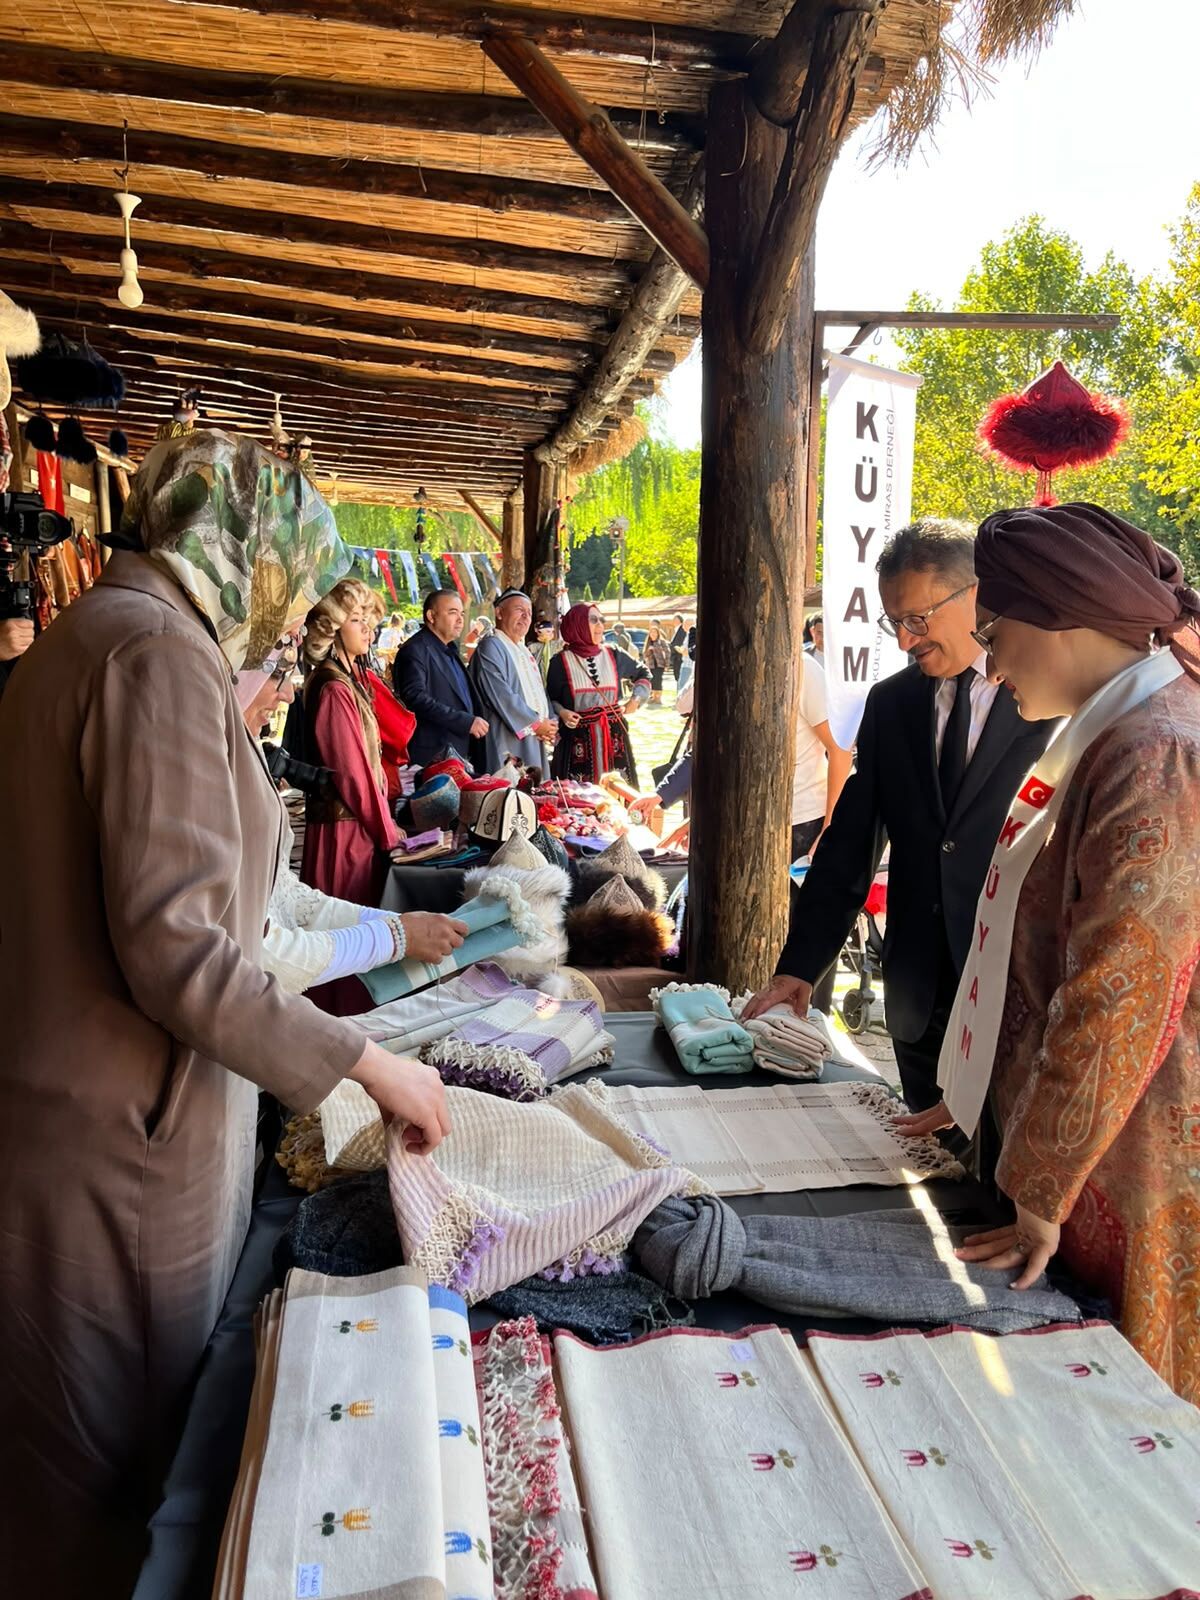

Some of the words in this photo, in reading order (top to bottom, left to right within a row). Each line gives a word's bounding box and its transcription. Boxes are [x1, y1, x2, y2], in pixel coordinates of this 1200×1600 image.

[844, 401, 879, 682] KÜYAM
[886, 408, 895, 478] DERNEĞİ
[961, 816, 1025, 1060] KÜYAM
